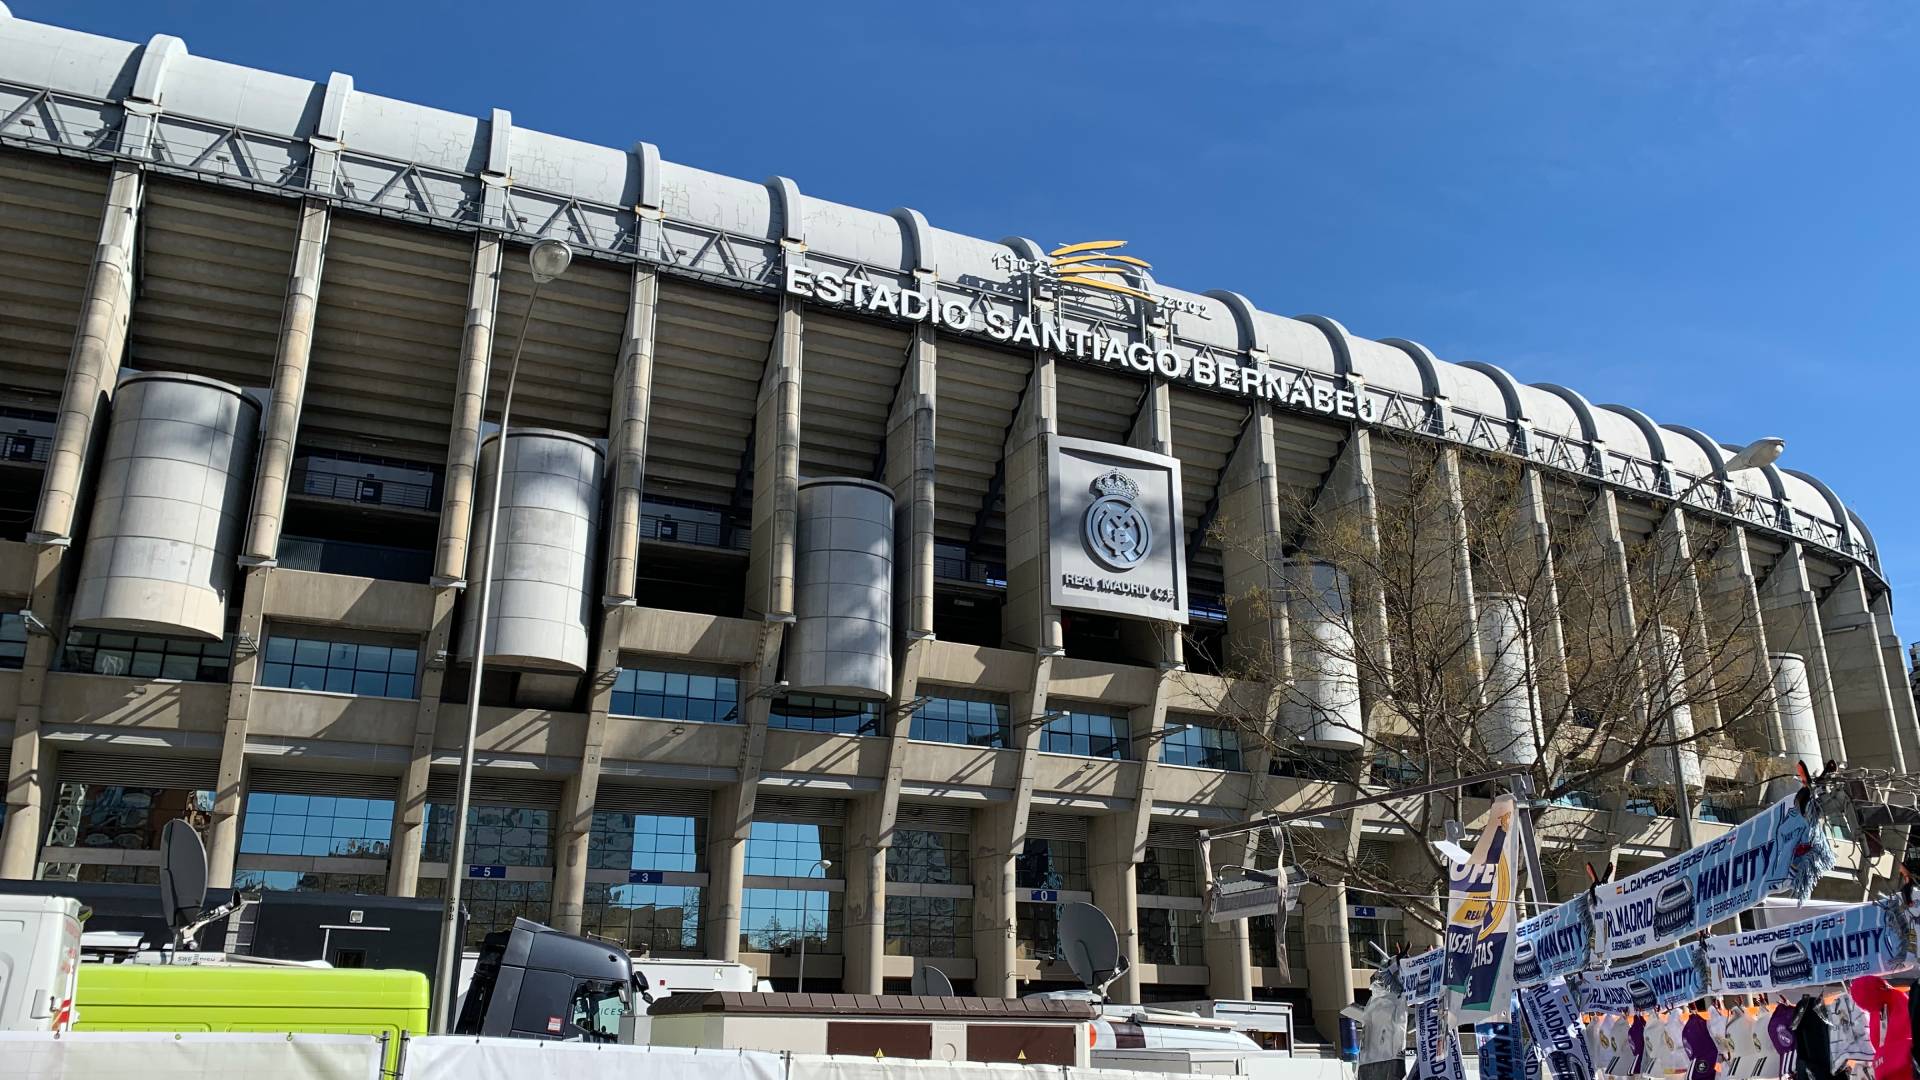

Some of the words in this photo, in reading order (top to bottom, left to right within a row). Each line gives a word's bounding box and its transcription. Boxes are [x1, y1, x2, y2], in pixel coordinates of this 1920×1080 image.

[786, 264, 971, 331] ESTADIO
[985, 310, 1181, 378] SANTIAGO
[1192, 356, 1377, 423] BERNABEU
[1065, 572, 1098, 588] REAL
[1101, 578, 1150, 597] MADRID
[483, 866, 491, 877] 5
[641, 872, 649, 882] 3
[1698, 862, 1730, 900] MAN
[1731, 840, 1776, 888] CITY
[1040, 890, 1048, 901] 0
[1362, 906, 1368, 916] 4
[1558, 922, 1583, 955] CITY
[1810, 936, 1849, 965] MAN
[1849, 927, 1884, 959] CITY
[1673, 966, 1696, 992] CITY
